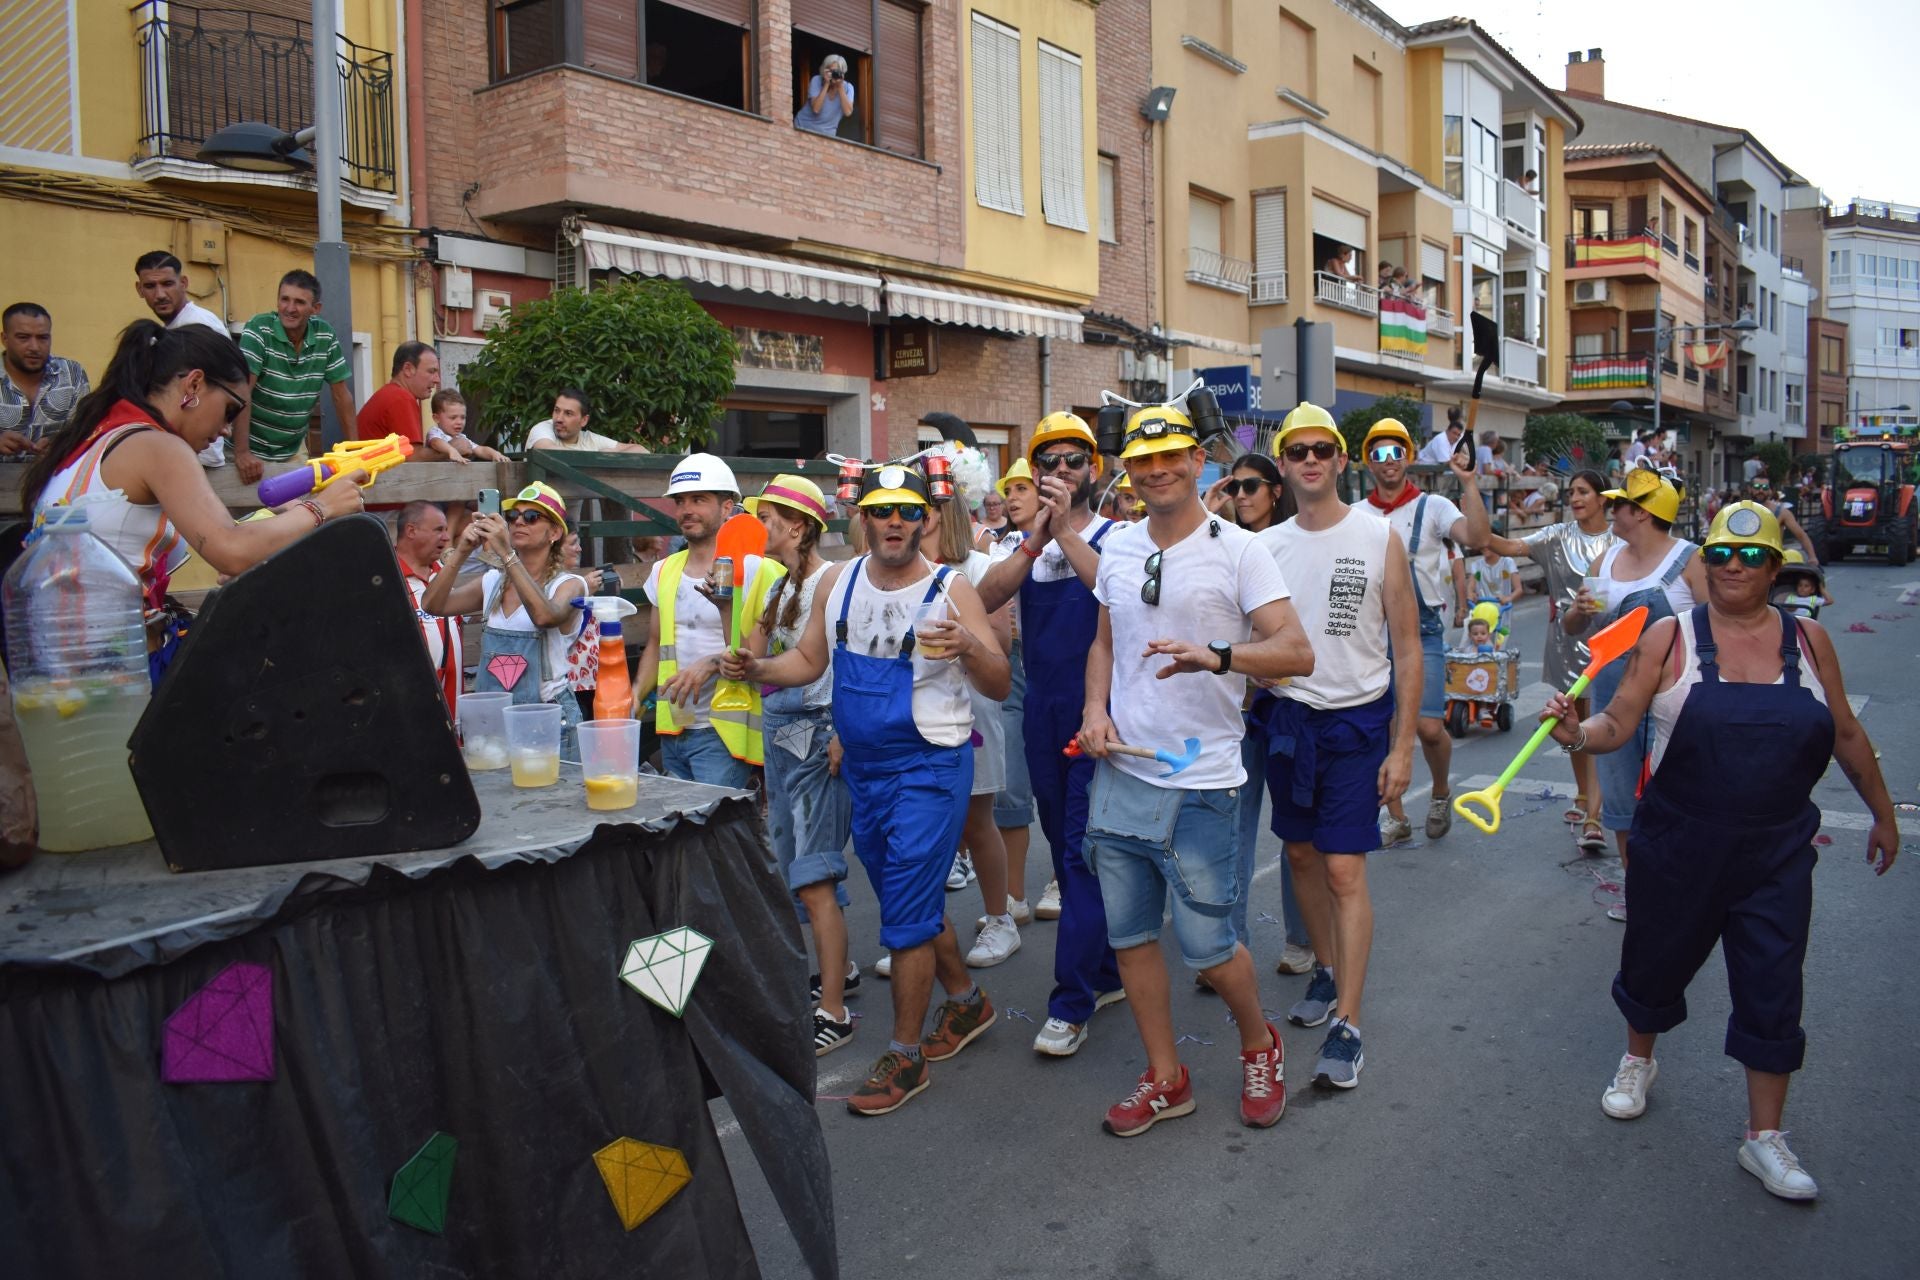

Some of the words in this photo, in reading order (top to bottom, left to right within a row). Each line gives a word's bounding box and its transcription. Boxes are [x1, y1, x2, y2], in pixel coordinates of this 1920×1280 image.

[895, 348, 924, 359] CERVEZAS
[894, 357, 925, 369] ALHAMBRA
[1210, 382, 1244, 396] BBVA
[1335, 557, 1366, 567] adidas
[1334, 567, 1365, 576] adidas
[1328, 612, 1357, 621] adidas
[1327, 621, 1357, 630] adidas
[1324, 628, 1351, 637] adidas
